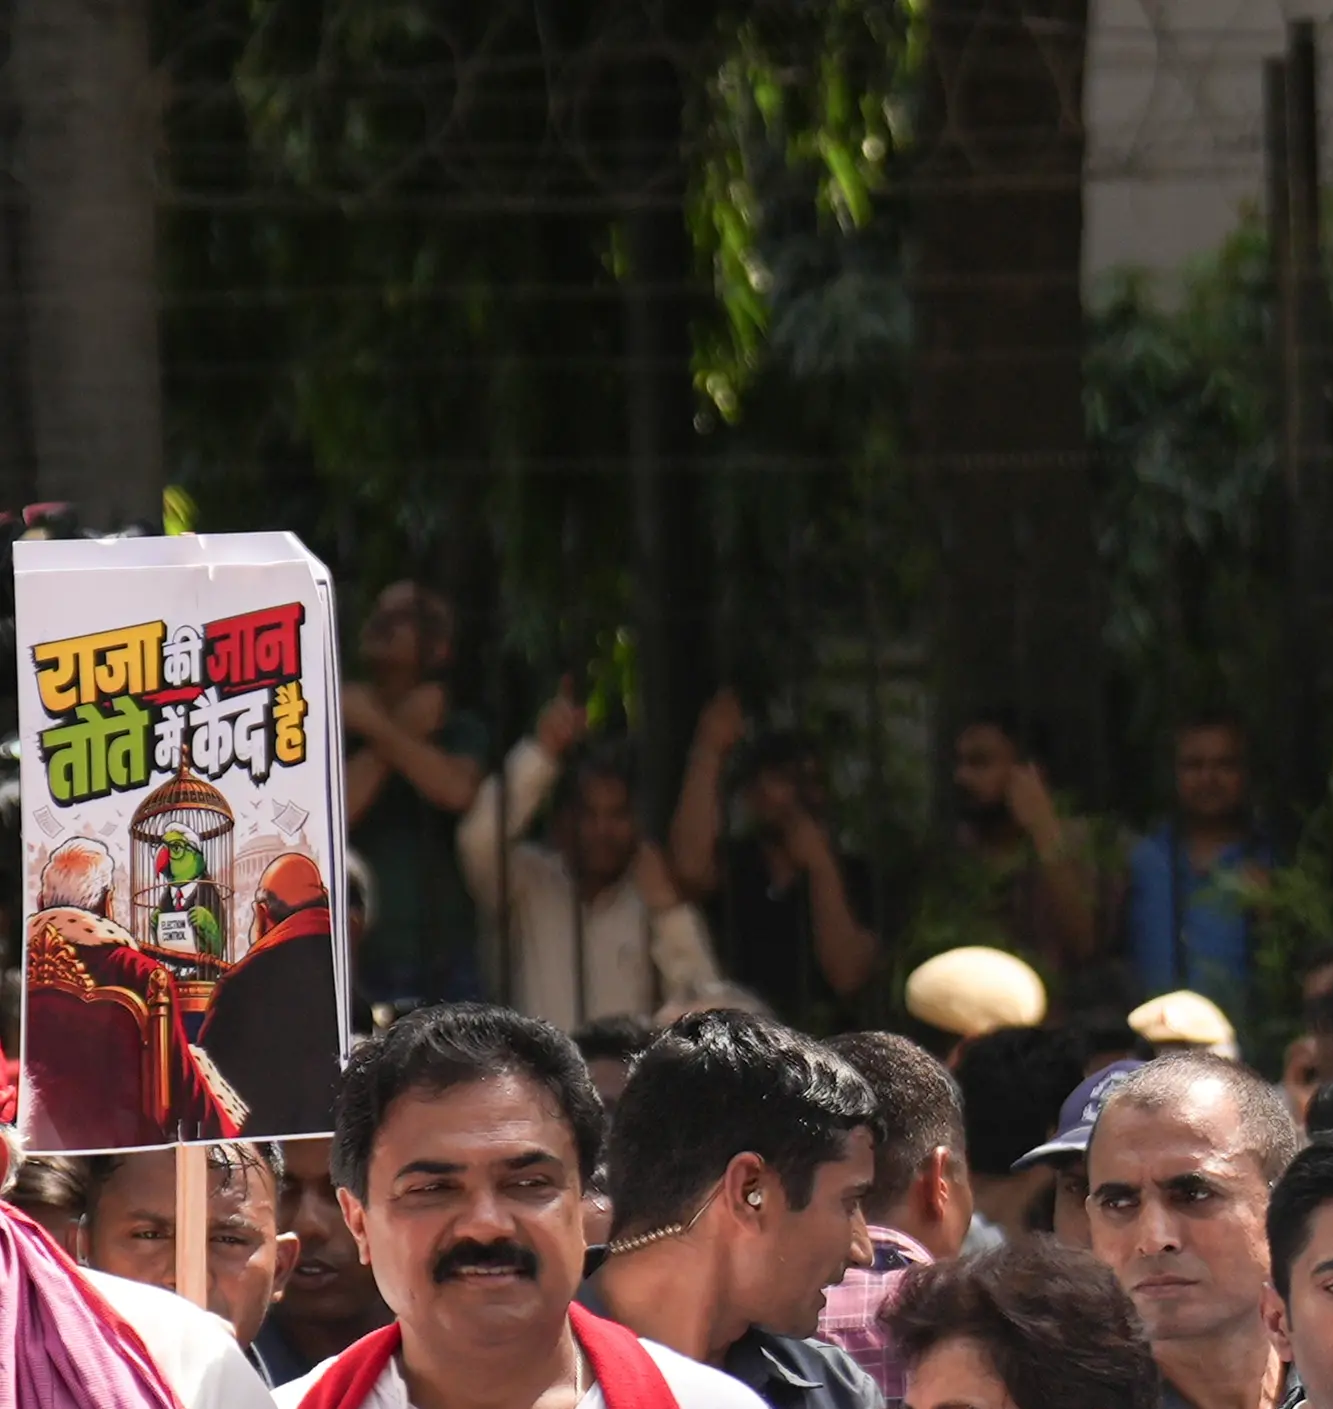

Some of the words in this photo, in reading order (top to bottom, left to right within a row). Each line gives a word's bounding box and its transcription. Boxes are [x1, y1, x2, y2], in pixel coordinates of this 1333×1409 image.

[33, 620, 165, 711] राजा
[163, 625, 203, 686] की
[203, 602, 303, 683] जान
[40, 695, 150, 800] तोते
[154, 704, 187, 769] में
[189, 686, 269, 779] कैद
[274, 680, 305, 763] है
